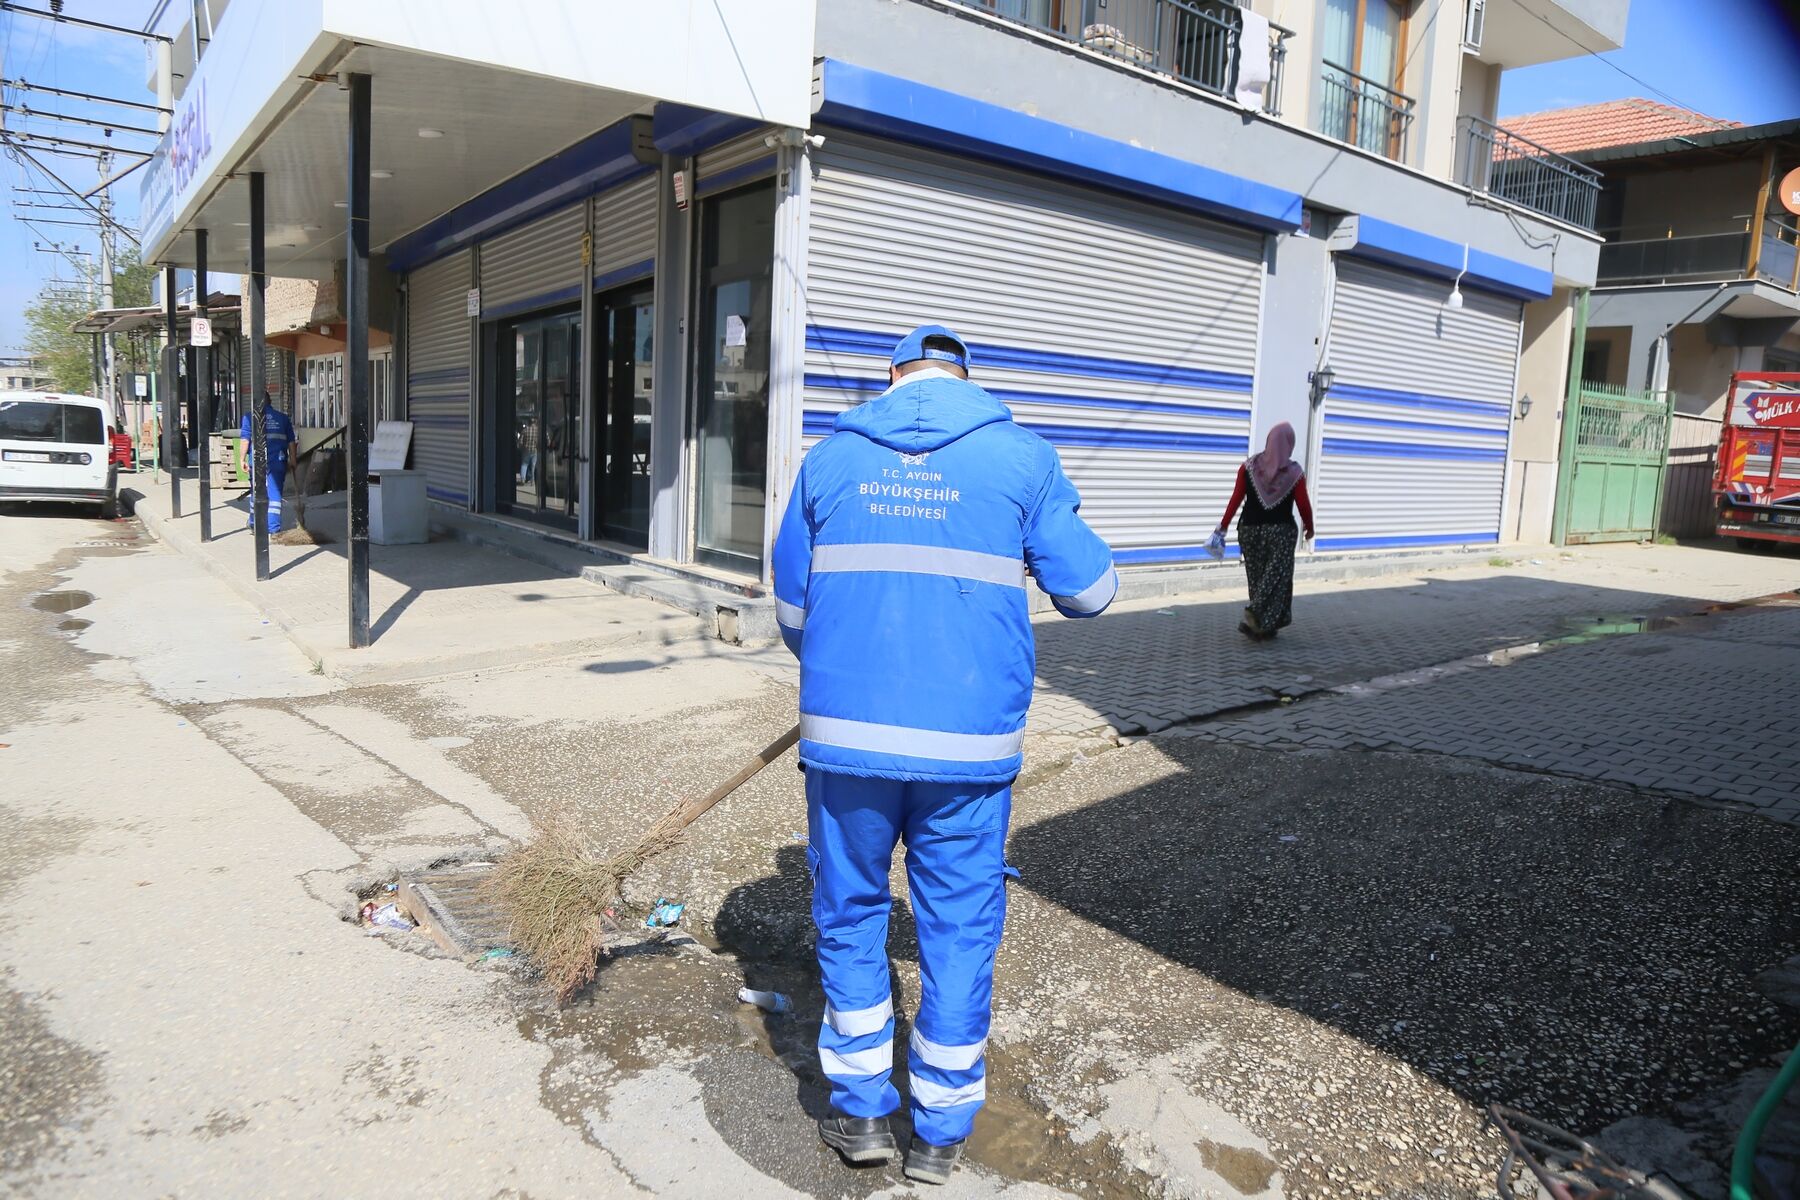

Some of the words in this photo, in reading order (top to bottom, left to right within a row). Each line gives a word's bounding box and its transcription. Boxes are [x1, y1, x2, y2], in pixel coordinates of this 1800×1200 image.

[1761, 400, 1794, 422] MÜLK
[882, 469, 902, 479] T.C.
[906, 471, 942, 481] AYDIN
[860, 481, 960, 502] BÜYÜKŞEHİR
[870, 503, 947, 520] BELEDİYESİ
